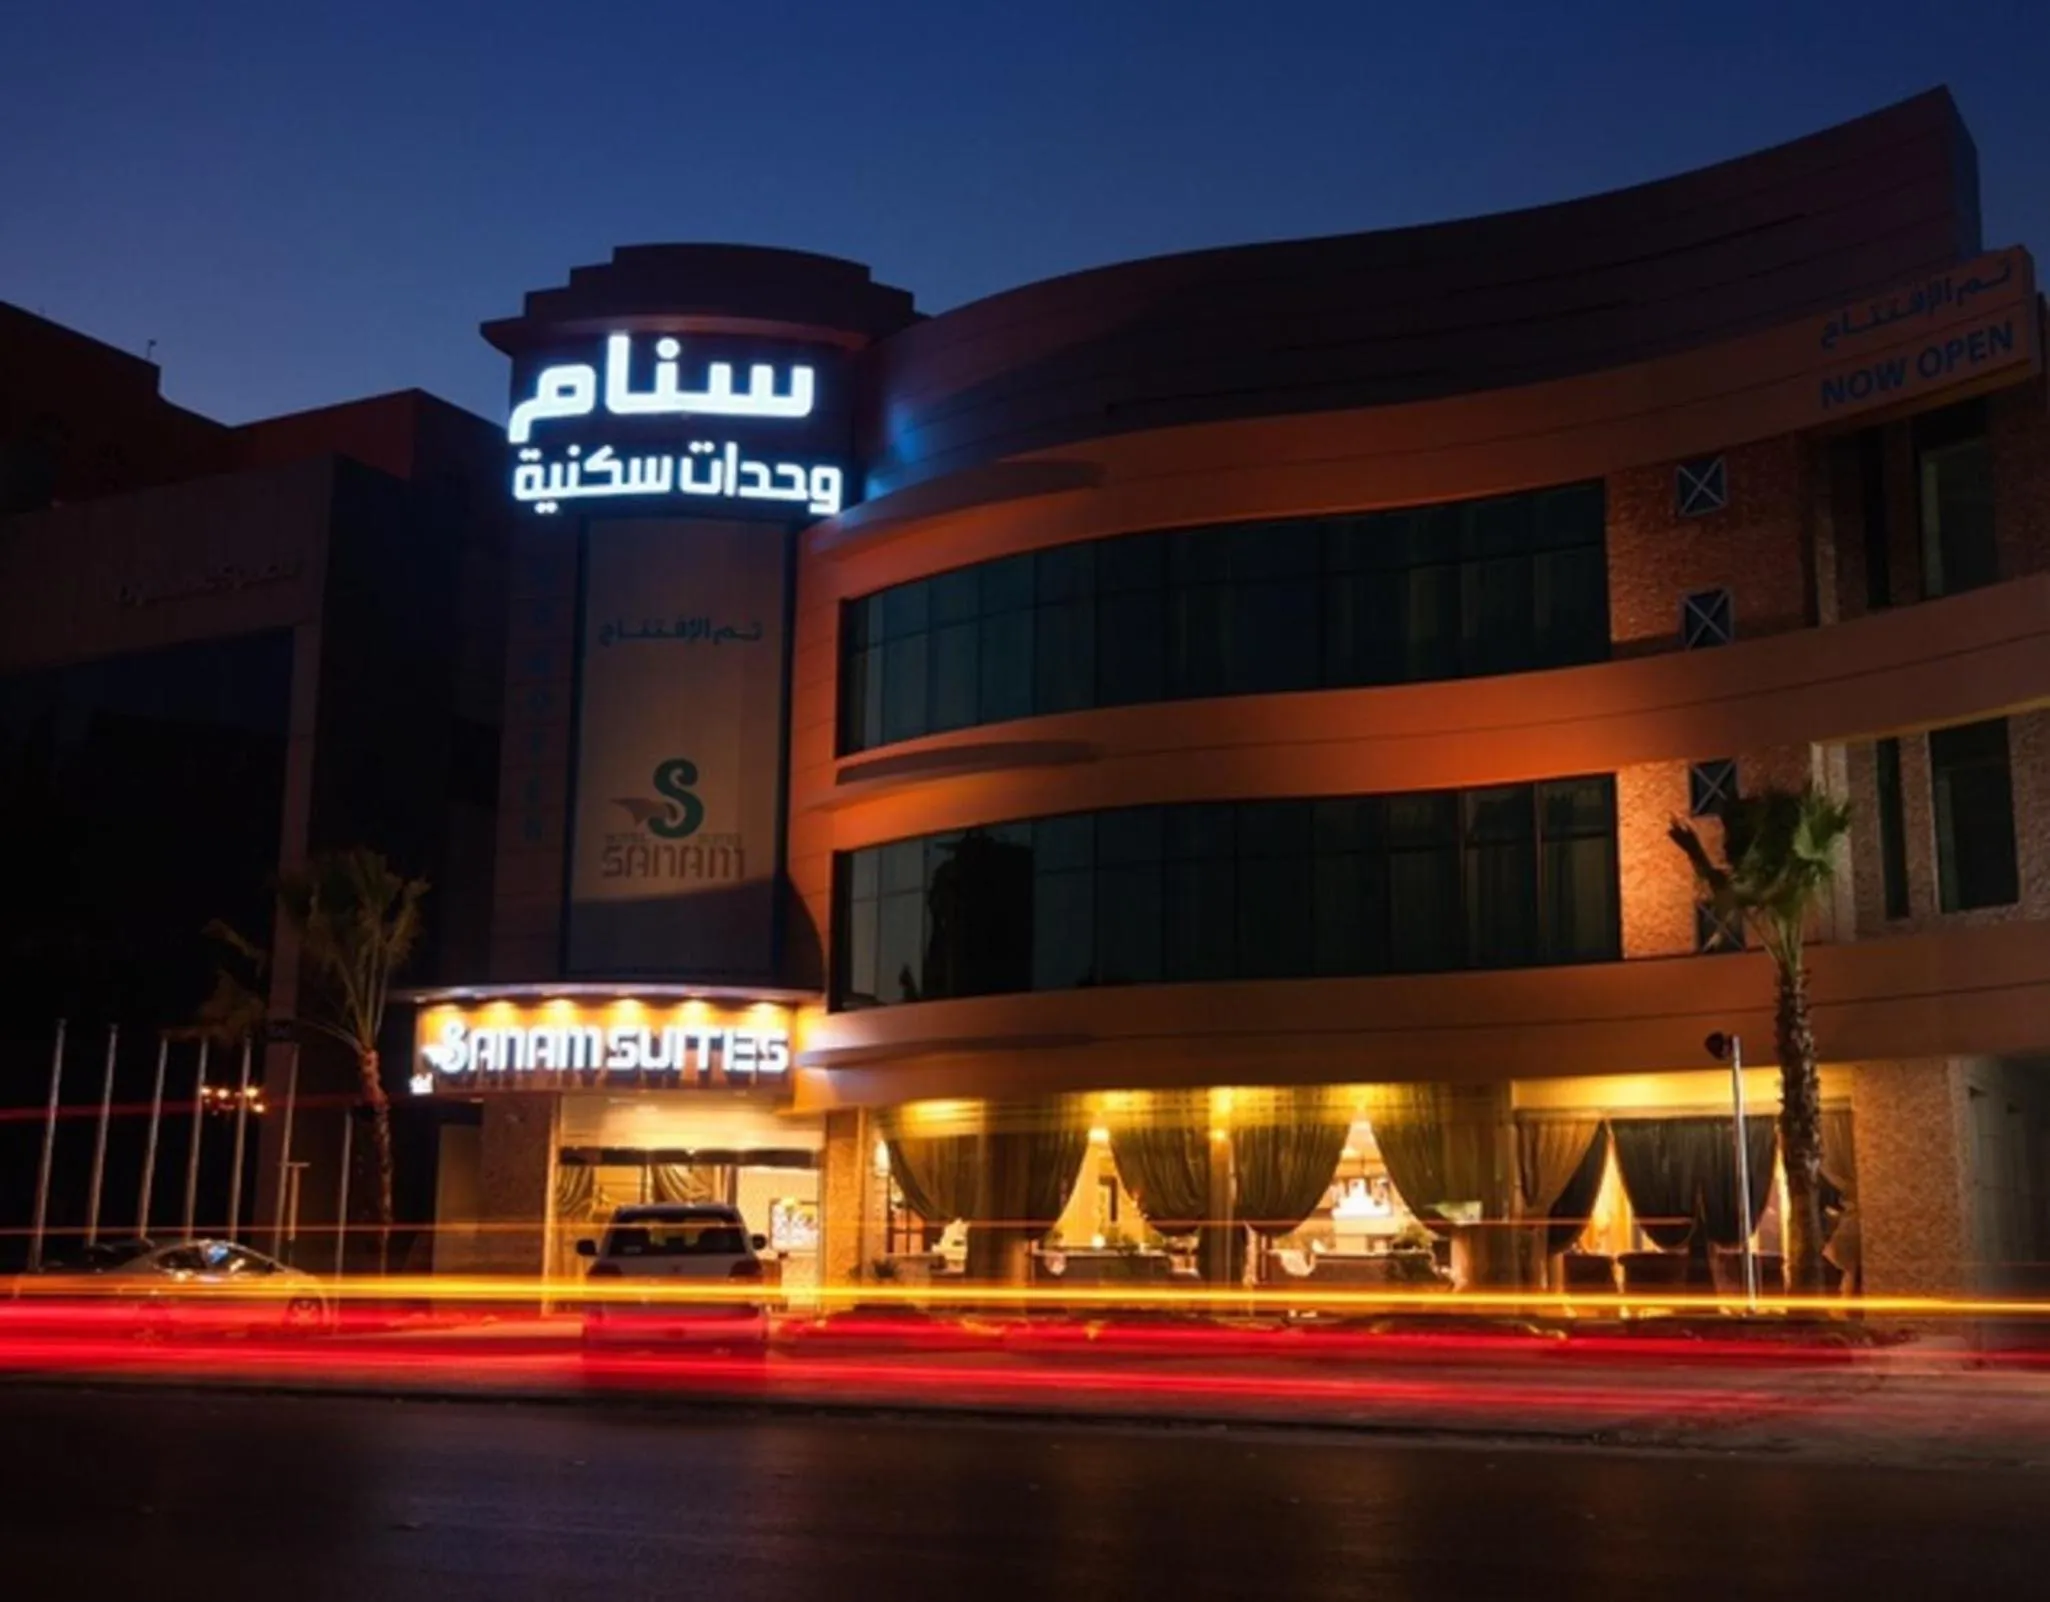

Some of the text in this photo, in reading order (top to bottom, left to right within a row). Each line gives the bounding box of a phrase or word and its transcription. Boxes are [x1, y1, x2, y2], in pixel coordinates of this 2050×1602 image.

[508, 332, 815, 443] سنام
[1821, 321, 2013, 410] NOW OPEN
[513, 441, 843, 515] وحدات سكنية
[602, 845, 744, 879] SANAM
[436, 1020, 790, 1074] SANAM SUITES
